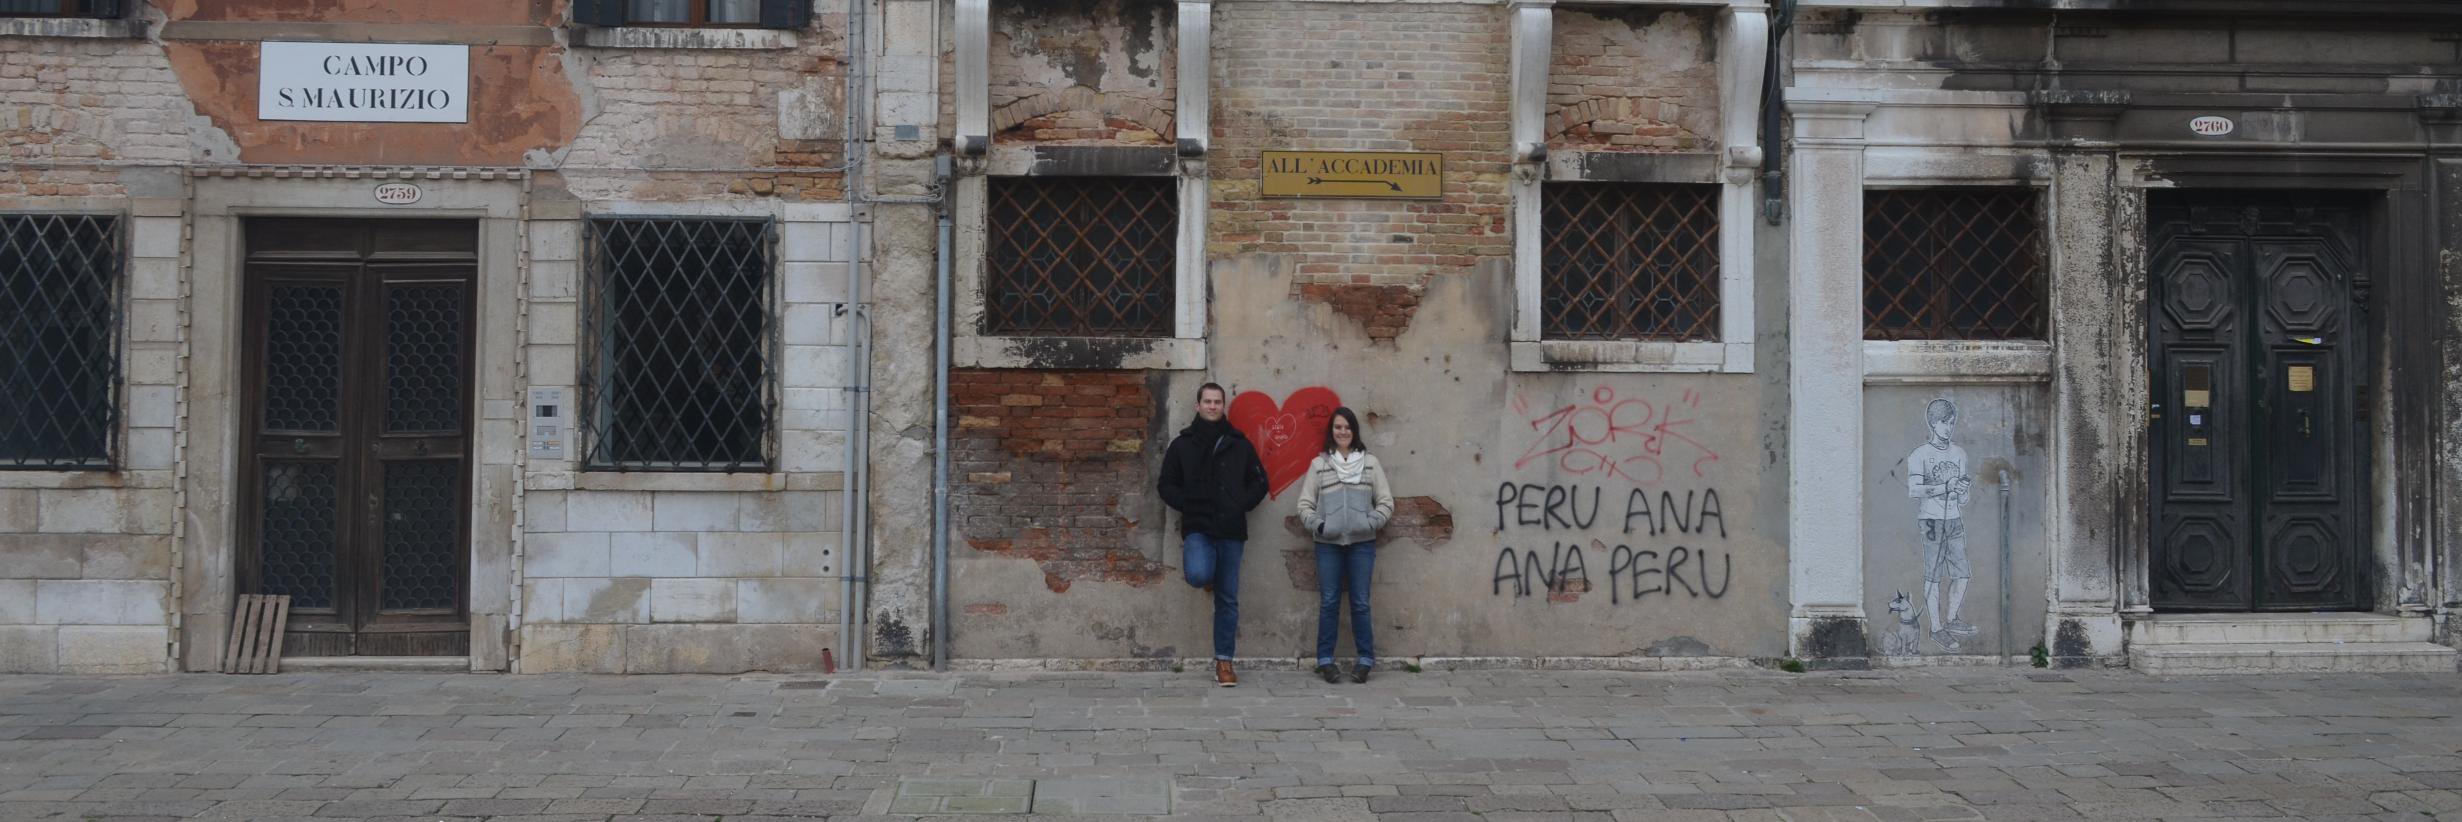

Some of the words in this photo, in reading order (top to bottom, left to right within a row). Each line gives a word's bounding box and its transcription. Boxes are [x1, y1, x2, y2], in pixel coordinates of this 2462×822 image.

[323, 55, 428, 76] CAMPO
[302, 87, 450, 110] MAURIZIO
[2194, 121, 2229, 132] 2760
[380, 187, 416, 199] 2759
[1496, 481, 1601, 531] PERU
[1623, 487, 1727, 539] ANA
[1493, 541, 1590, 597] ANA
[1609, 544, 1731, 604] PERU
